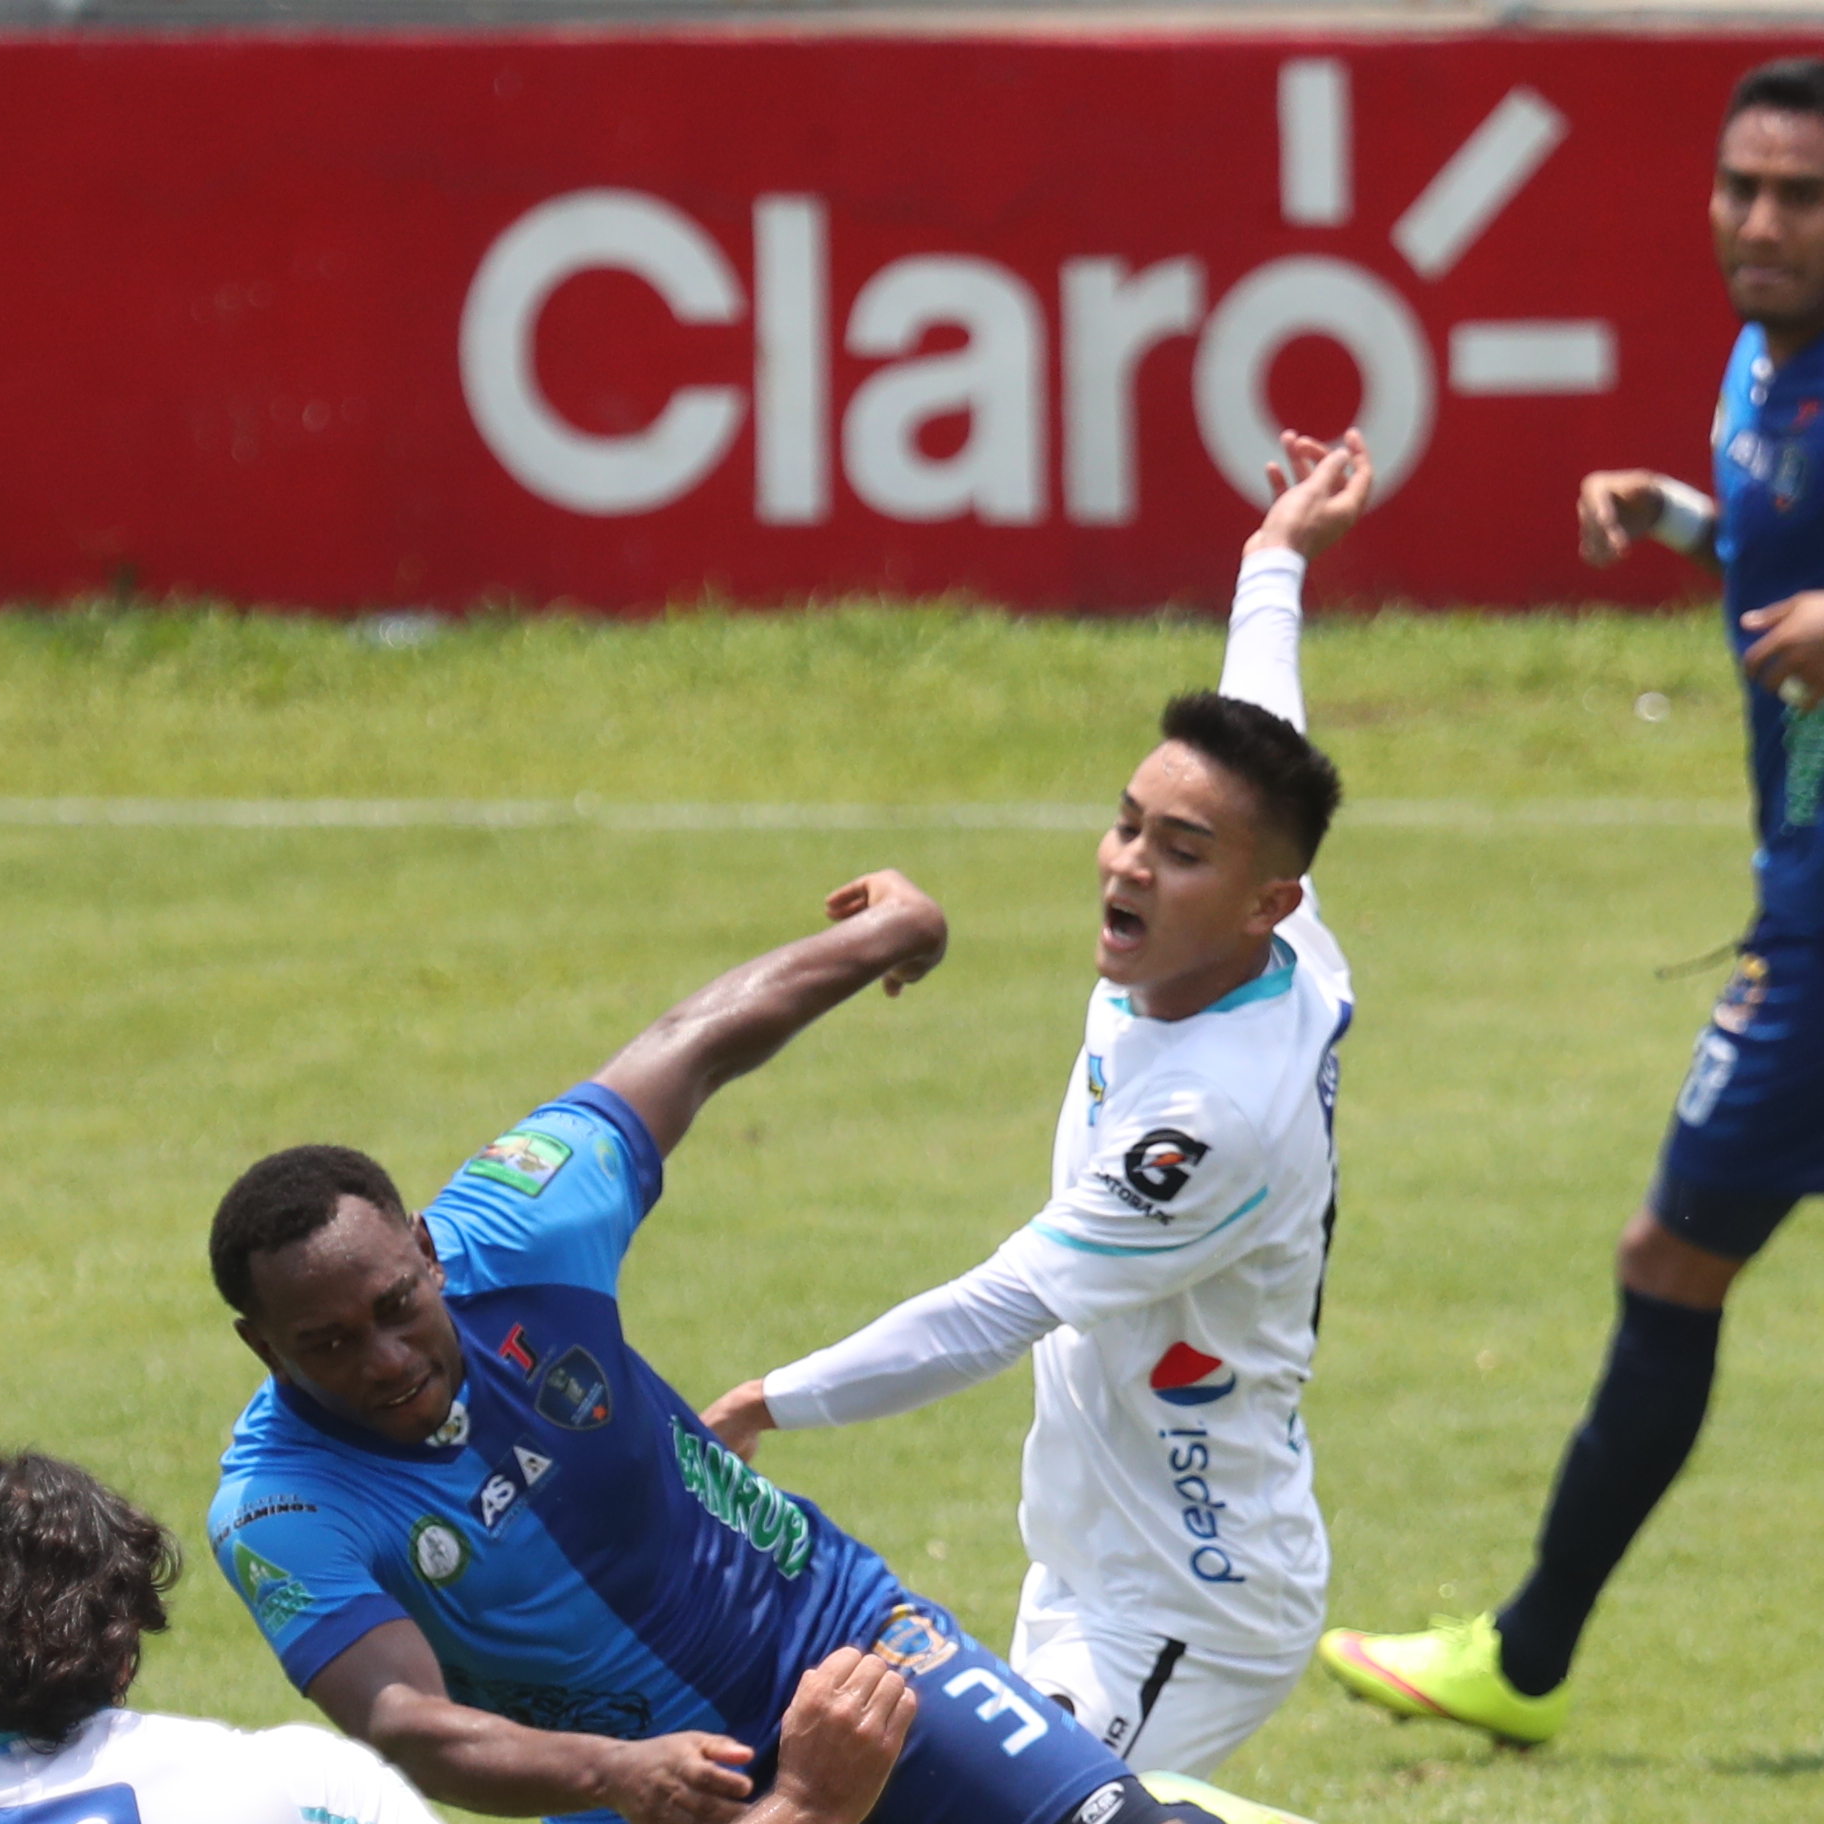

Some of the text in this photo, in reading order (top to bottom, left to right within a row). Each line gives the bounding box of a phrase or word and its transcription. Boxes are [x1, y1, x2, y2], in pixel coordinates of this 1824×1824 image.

[460, 188, 1435, 525] Claro
[1160, 1427, 1246, 1583] pepsi
[942, 1667, 1048, 1757] 3
